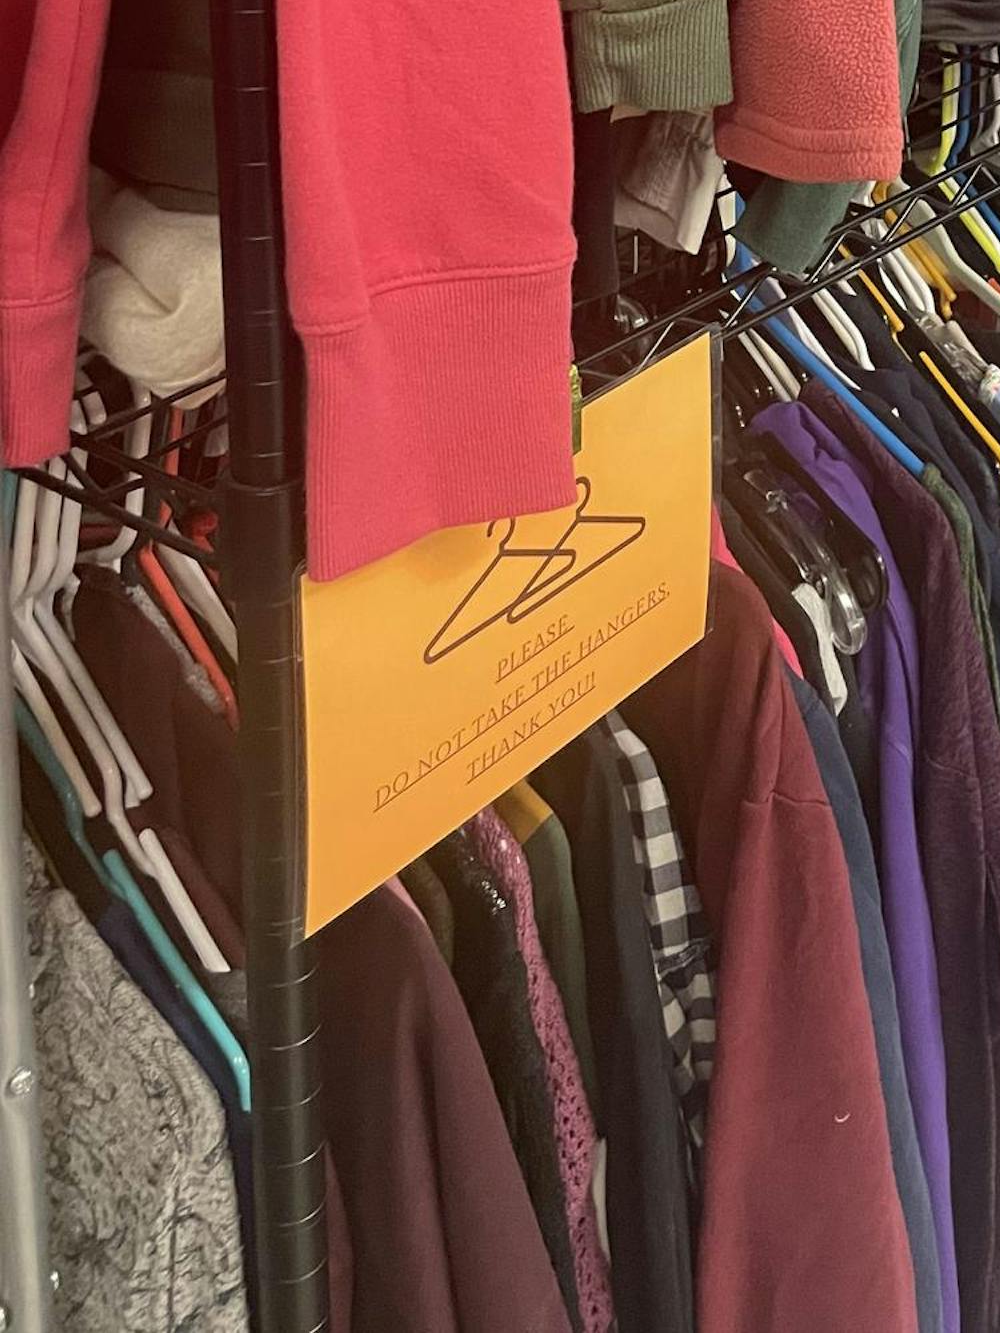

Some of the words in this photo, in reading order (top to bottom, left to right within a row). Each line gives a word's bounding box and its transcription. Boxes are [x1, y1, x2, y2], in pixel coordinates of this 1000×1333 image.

[375, 771, 410, 809] DO
[417, 728, 466, 777] NOT
[472, 685, 525, 736] TAKE
[531, 651, 571, 692] THE
[579, 582, 670, 657] HANGERS.
[496, 614, 572, 682] PLEASE
[467, 715, 540, 783] THANK
[548, 671, 596, 712] YOU!
